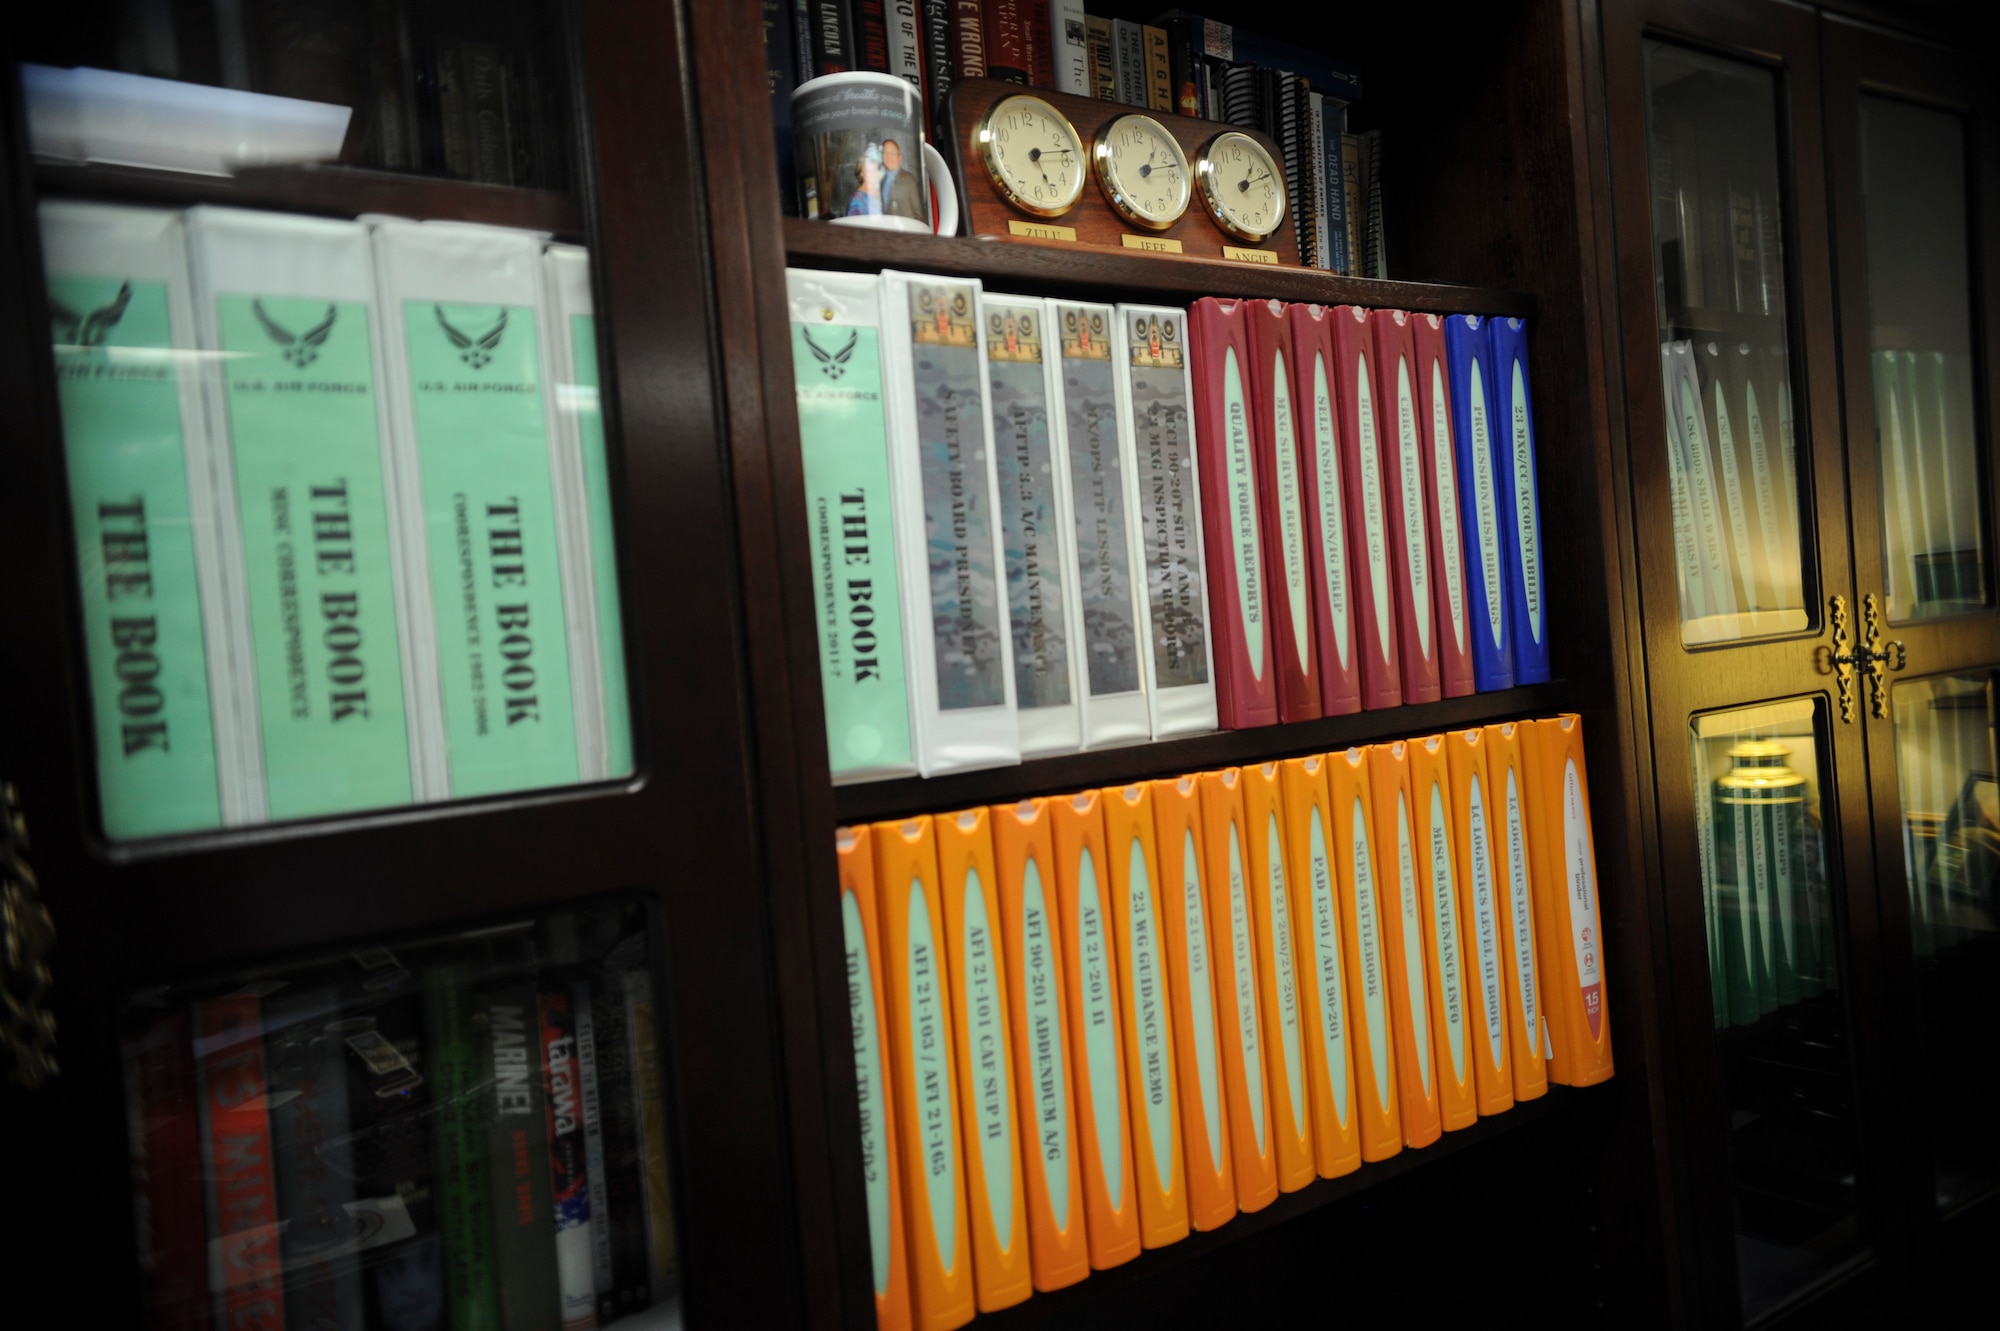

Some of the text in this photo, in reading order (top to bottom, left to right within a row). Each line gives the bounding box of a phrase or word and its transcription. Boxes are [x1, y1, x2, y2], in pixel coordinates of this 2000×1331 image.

[820, 1, 842, 56] LINCOLN
[902, 21, 914, 36] OF
[903, 43, 917, 69] THE
[959, 16, 984, 77] WRONG
[1120, 27, 1131, 67] OF THE
[1073, 55, 1085, 87] The
[1096, 43, 1112, 71] NOT
[1098, 72, 1113, 83] A
[1130, 30, 1144, 102] THE OTHER
[1020, 111, 1033, 128] 12
[1052, 132, 1061, 148] 2
[1132, 129, 1144, 145] 12
[1059, 171, 1067, 187] 4
[1160, 151, 1169, 165] 2
[1231, 148, 1242, 162] 12
[1327, 153, 1340, 186] DEAD
[1263, 184, 1272, 200] 3
[1330, 188, 1342, 221] HAND
[273, 381, 306, 394] AIR
[307, 382, 369, 396] FORCE
[452, 381, 480, 394] AIR
[481, 382, 538, 395] FORCE
[838, 389, 879, 403] FORCE
[1433, 400, 1445, 427] AFI
[942, 386, 969, 543] SAFETY BOARD
[1400, 395, 1425, 588] CBRNE RESPONSE BOOK
[1473, 405, 1495, 549] PROFESSIONALISM
[1685, 414, 1719, 562] CSC 8905 SMALL WARS
[1092, 475, 1108, 511] TTP
[1230, 401, 1261, 626] QUALITY FORCE REPORTS
[1276, 397, 1300, 590] MXG SURVEY REPORTS
[1317, 394, 1344, 614] SELF INSPECTION/IG PREP
[1442, 484, 1455, 530] USAF
[1514, 405, 1540, 617] 23 MXG/CC ACCOUNTABILITY
[1021, 506, 1036, 540] A/C
[1172, 512, 1188, 550] SUP
[1369, 530, 1382, 565] 1-02
[1096, 515, 1115, 602] LESSONS
[1149, 431, 1181, 673] MXG INSPECTION REPORTS
[1445, 529, 1463, 622] INSPECTION
[308, 477, 374, 725] THE BOOK
[485, 496, 541, 728] THE BOOK
[839, 486, 881, 684] THE BOOK
[1024, 543, 1049, 680] MAINTENANCE
[1177, 570, 1192, 608] AND
[97, 491, 172, 760] THE BOOK
[1471, 804, 1482, 825] LC
[1272, 862, 1284, 892] AFI
[1472, 826, 1490, 909] LOGISTICS
[1578, 857, 1590, 911] professional
[1025, 905, 1043, 940] AFI
[1185, 880, 1205, 974] AFI 21-101
[1355, 840, 1380, 1000] SCPR BATTLEBOOK
[1432, 826, 1461, 1026] MISC MAINTENANCE INFO
[1479, 908, 1496, 959] LEVEL
[1508, 796, 1537, 1017] LC LOGISTICS LEVEL BOOK
[1029, 943, 1049, 1008] 90-201
[1083, 905, 1106, 1028] AFI 21-201 II
[1313, 855, 1342, 1042] PAD 13-01 AFI 90-201
[1131, 890, 1164, 1107] 23 WG GUIDANCE MEMO
[1486, 983, 1502, 1029] BOOK
[577, 1020, 595, 1061] FLIGHT
[913, 943, 947, 1178] AFI 21-103 AFI 21-165
[969, 925, 1003, 1141] AFI 21-101 CAF SUP II
[488, 1004, 534, 1118] MARINE!
[545, 1034, 578, 1141] tarawa
[1034, 1012, 1059, 1124] ADDENDUM
